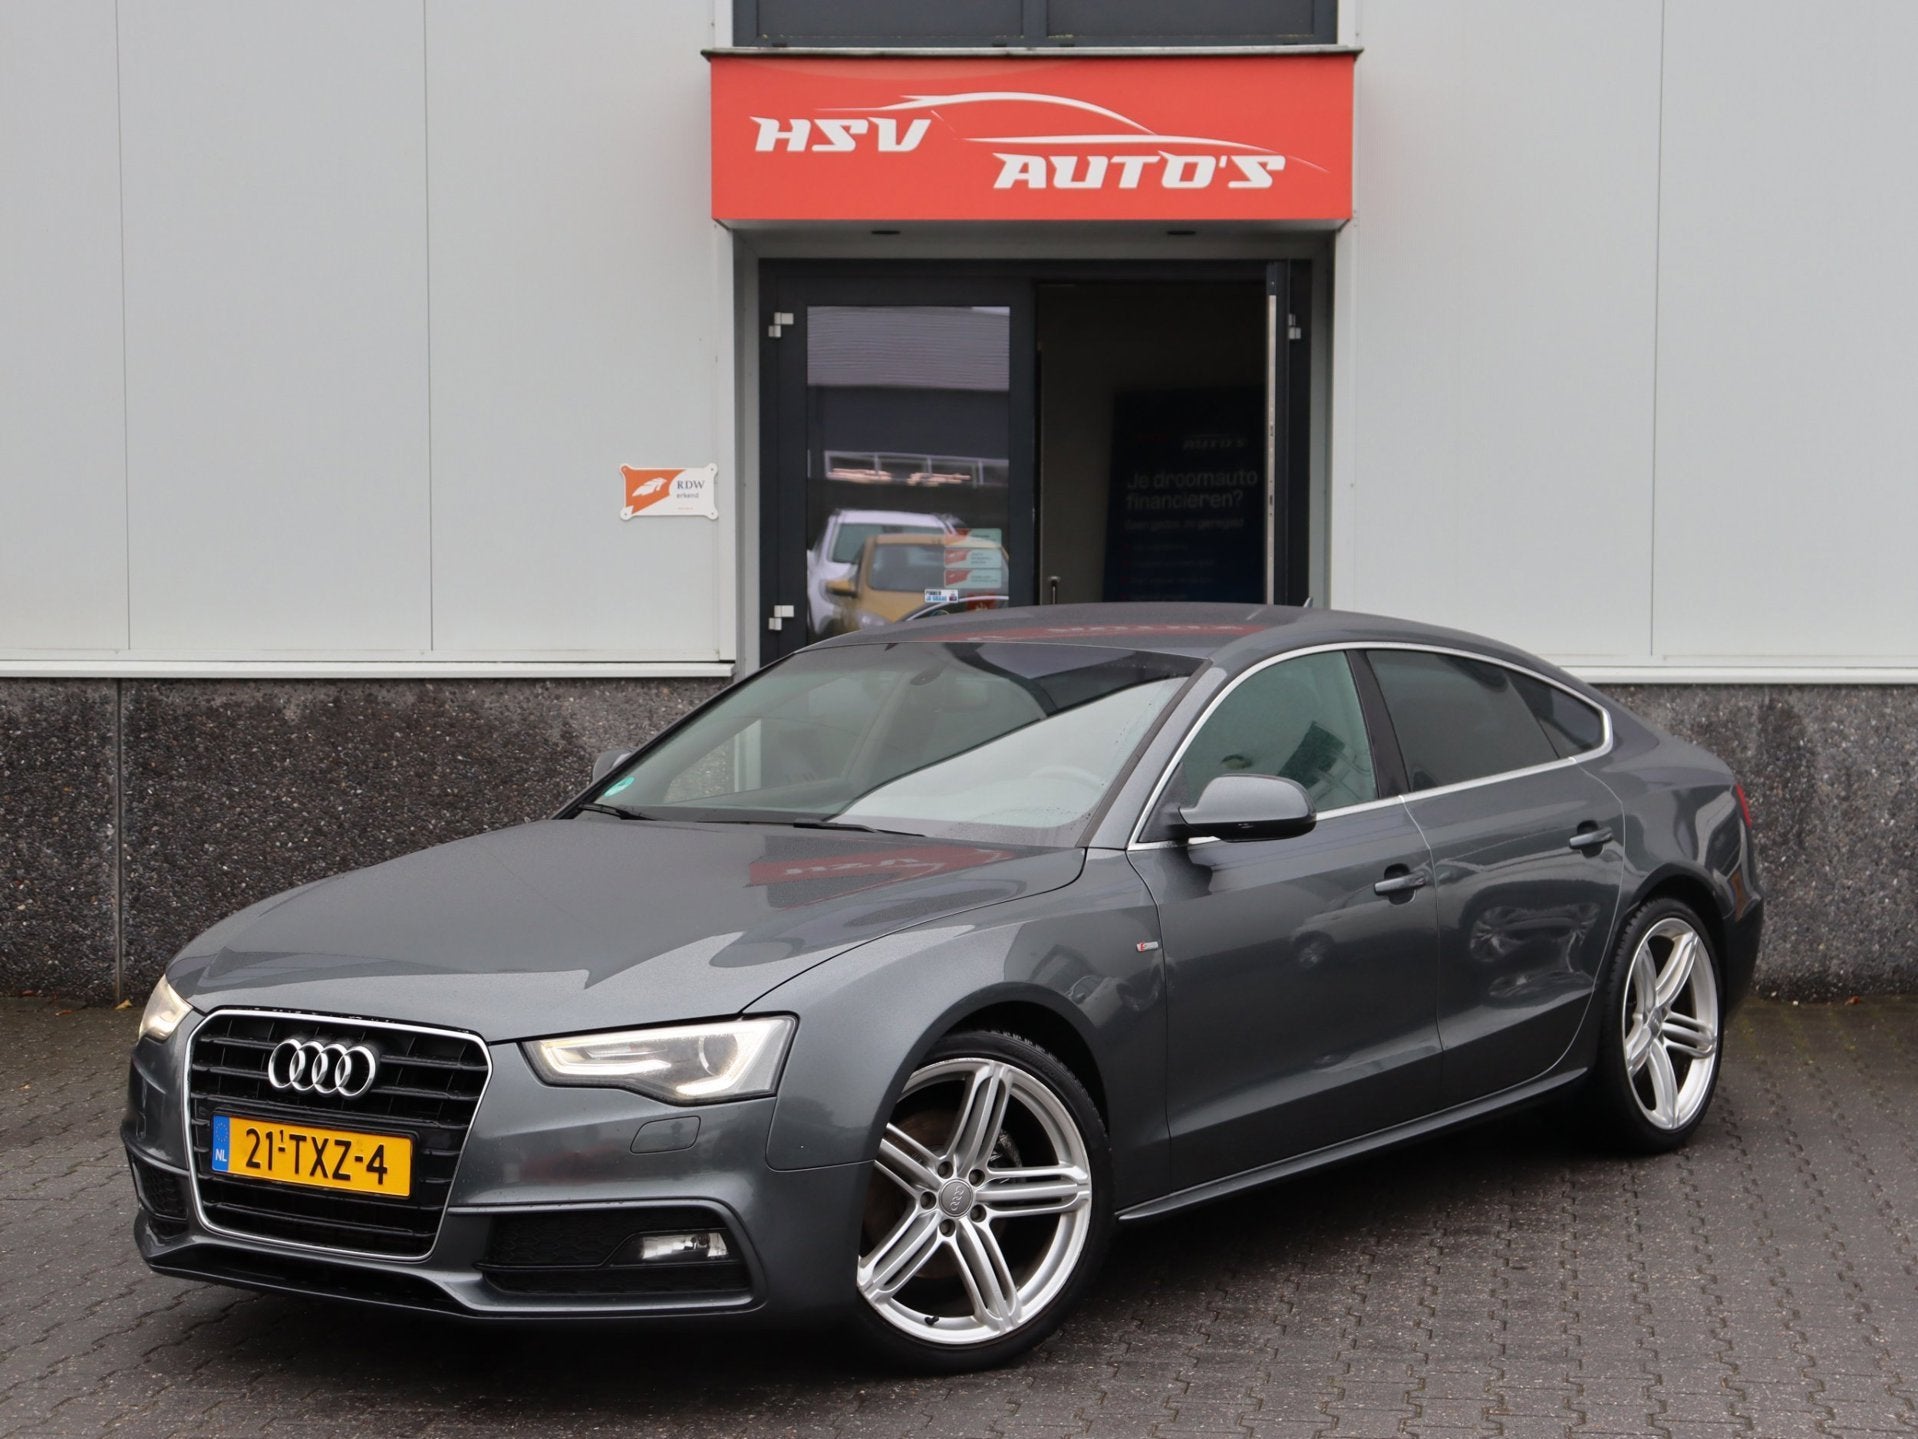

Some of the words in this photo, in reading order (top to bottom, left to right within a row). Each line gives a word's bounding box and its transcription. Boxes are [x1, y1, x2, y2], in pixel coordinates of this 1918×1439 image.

[750, 116, 932, 153] HSV
[992, 150, 1286, 189] AUTO'S
[676, 480, 705, 490] RDW
[1127, 470, 1149, 489] Je
[1153, 468, 1258, 489] droomauto
[1126, 490, 1243, 510] financieren?
[215, 1149, 227, 1162] NL
